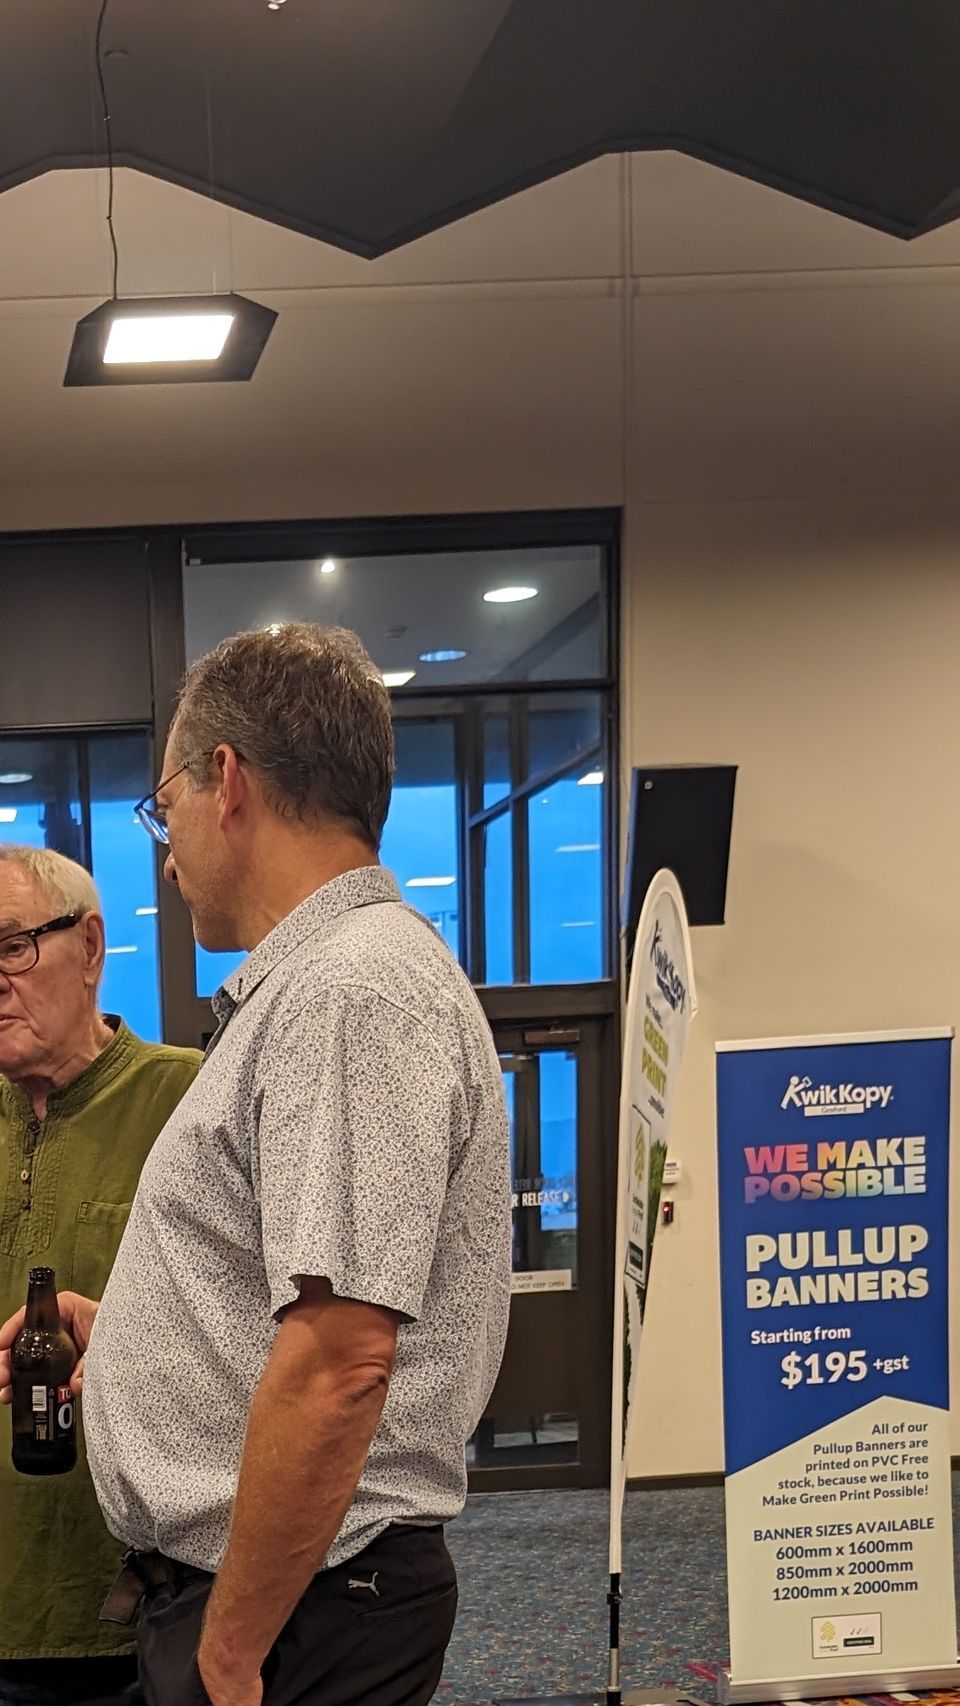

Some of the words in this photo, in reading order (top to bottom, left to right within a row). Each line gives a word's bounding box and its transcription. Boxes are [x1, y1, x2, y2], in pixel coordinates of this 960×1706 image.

[781, 1076, 893, 1109] KwikKopy
[744, 1143, 808, 1174] WE
[817, 1136, 926, 1171] MAKE
[744, 1165, 927, 1204] POSSIBLE
[521, 1190, 561, 1207] RELEASE
[746, 1224, 929, 1272] PULLUP
[746, 1268, 929, 1309] BANNERS
[751, 1328, 811, 1344] Starting
[814, 1326, 851, 1340] from
[780, 1350, 868, 1390] $195
[873, 1355, 909, 1374] +gst
[871, 1424, 889, 1435] All
[891, 1422, 905, 1434] of
[907, 1423, 928, 1434] our
[813, 1443, 853, 1456] Pullup
[855, 1441, 906, 1453] Banners
[908, 1440, 928, 1449] are
[805, 1458, 850, 1473] printed
[853, 1460, 869, 1469] on
[871, 1455, 899, 1467] PVC
[901, 1454, 929, 1465] Free
[778, 1477, 815, 1489] stock,
[817, 1475, 867, 1487] because
[870, 1473, 888, 1483] we
[890, 1470, 913, 1482] like
[916, 1470, 929, 1480] to
[762, 1495, 797, 1507] Make
[799, 1492, 837, 1505] Green
[839, 1489, 871, 1501] Print
[873, 1485, 929, 1499] Possible!
[753, 1526, 813, 1542] BANNER
[816, 1523, 853, 1537] SIZES
[855, 1517, 935, 1534] AVAILABLE
[776, 1546, 832, 1560] 600mm
[835, 1546, 845, 1556] x
[848, 1540, 913, 1555] 1600mm
[776, 1566, 832, 1580] 850mm
[835, 1566, 845, 1576] x
[848, 1560, 913, 1575] 2000mm
[772, 1586, 837, 1601] 1200mm
[840, 1586, 850, 1596] x
[853, 1579, 918, 1595] 2000mm
